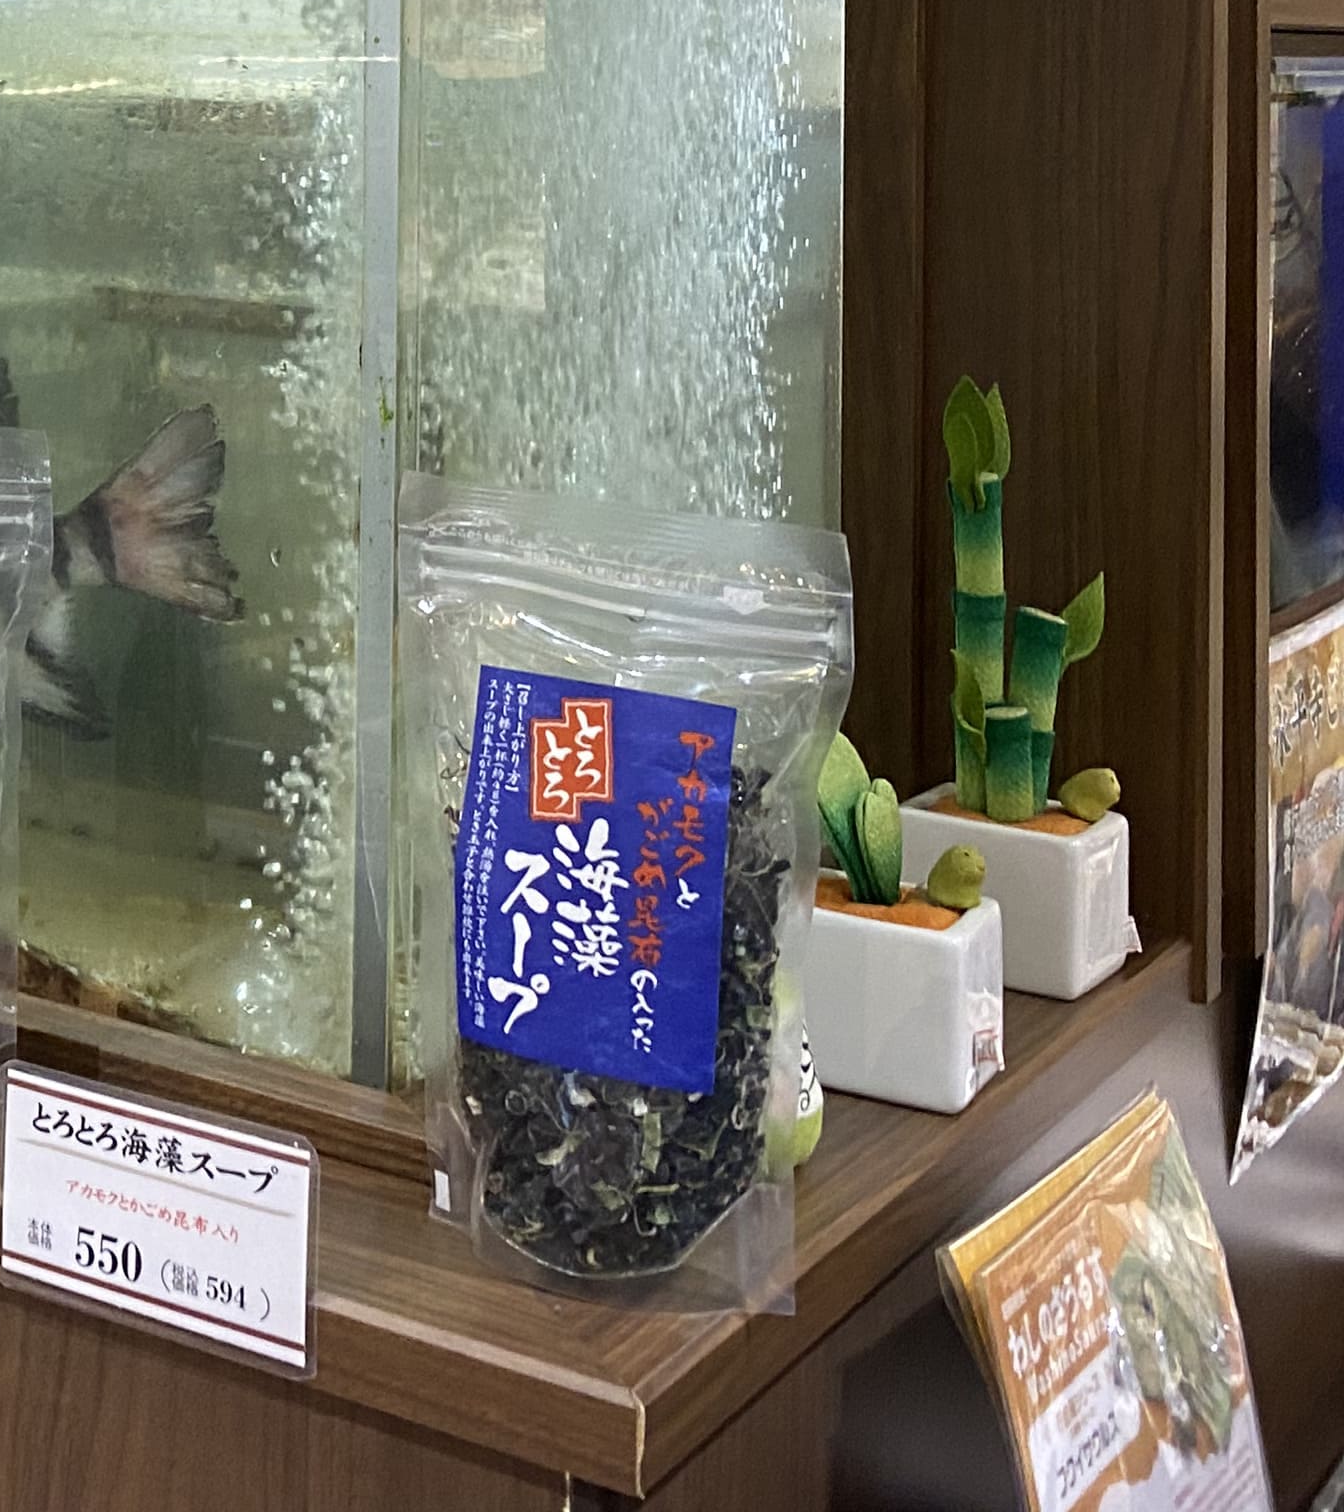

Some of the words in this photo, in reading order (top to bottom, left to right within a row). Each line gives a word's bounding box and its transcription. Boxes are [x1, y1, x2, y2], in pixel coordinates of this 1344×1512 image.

[487, 849, 551, 1034] スープ
[31, 1102, 279, 1194] とろとろ海藻スープ
[75, 1227, 143, 1283] 550
